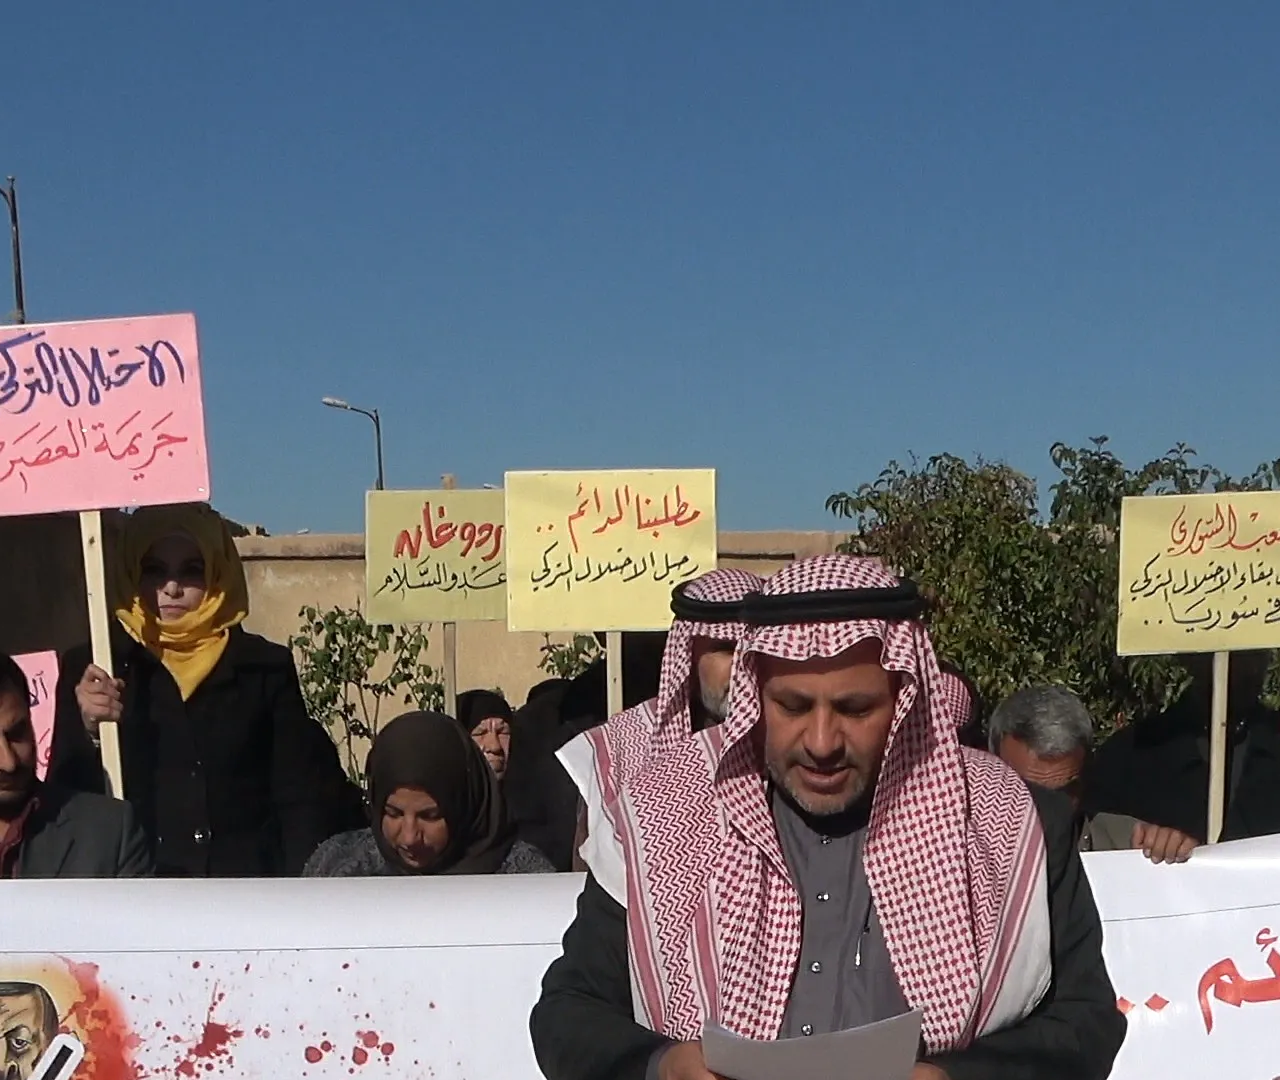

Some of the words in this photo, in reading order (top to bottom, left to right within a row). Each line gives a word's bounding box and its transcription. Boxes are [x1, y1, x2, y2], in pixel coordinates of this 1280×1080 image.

[567, 481, 630, 553] الدائم
[635, 484, 701, 538] مطلبنا
[530, 541, 573, 592] التركي
[1129, 553, 1173, 601] التركي
